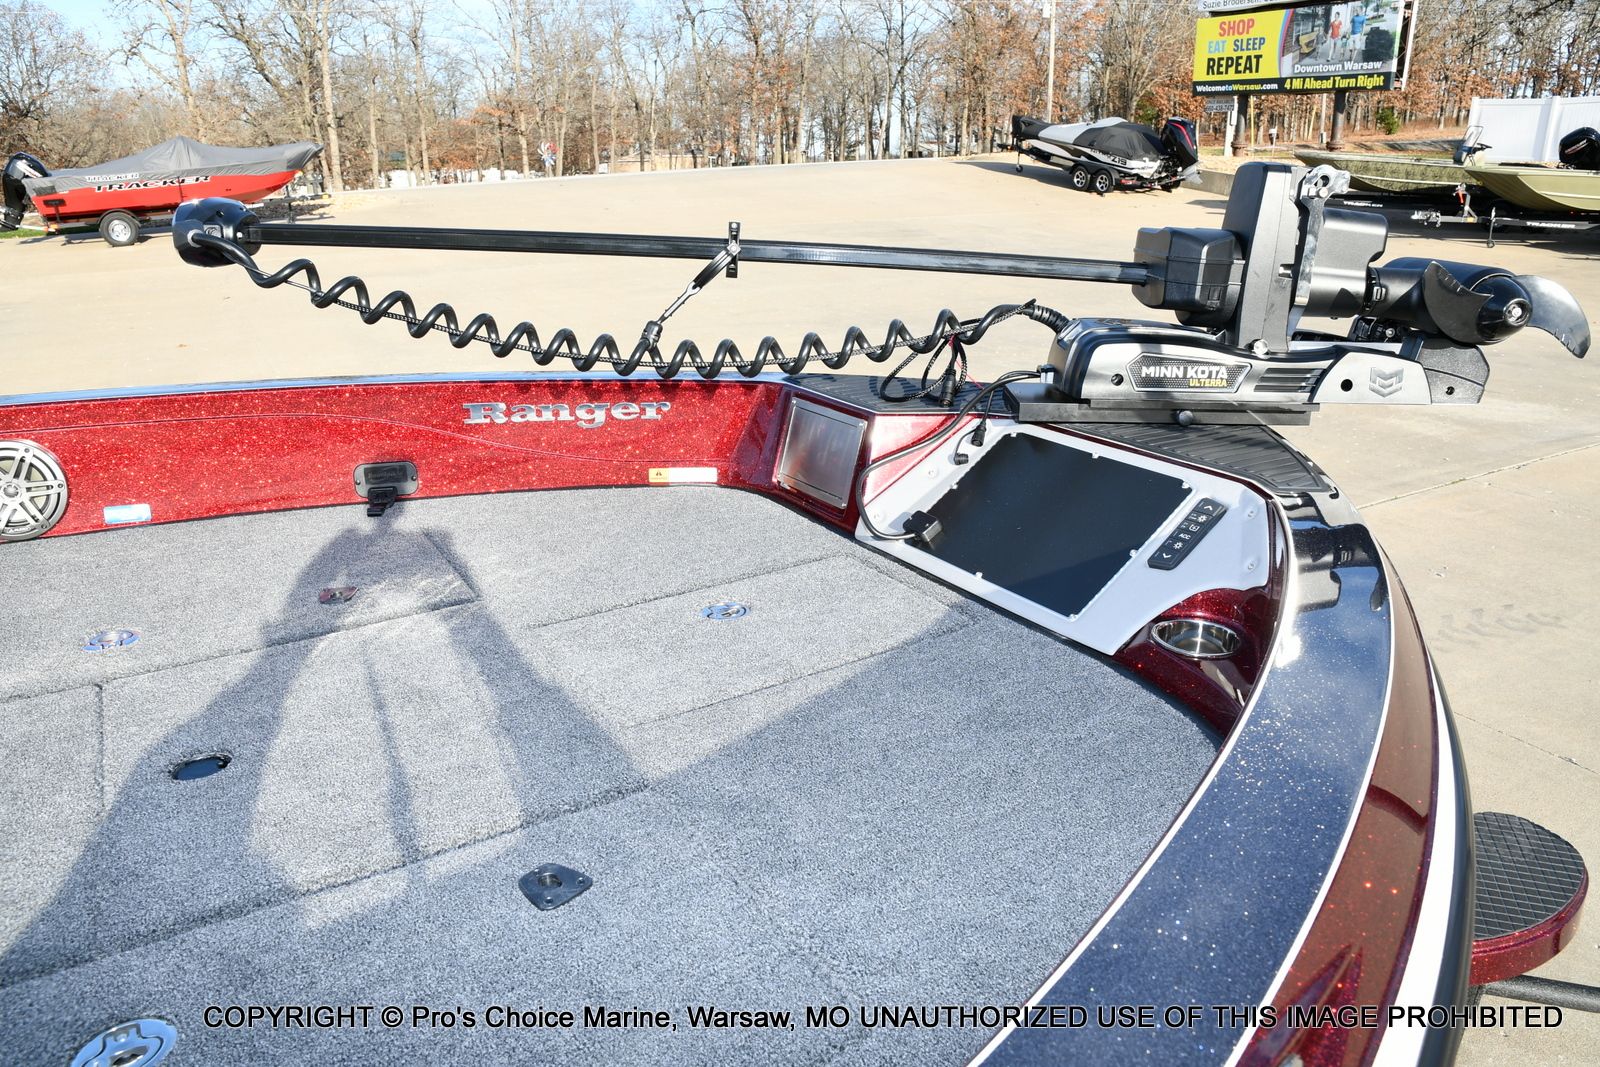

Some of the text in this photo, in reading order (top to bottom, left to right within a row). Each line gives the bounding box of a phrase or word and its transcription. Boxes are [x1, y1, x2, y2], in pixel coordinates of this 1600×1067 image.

[1219, 18, 1255, 37] SHOP
[1208, 37, 1266, 54] EAT SLEEP
[1206, 54, 1262, 76] REPEAT
[1294, 60, 1383, 74] Downtown Warsaw
[1196, 82, 1278, 92] WelcometoWarsaw.com
[1284, 74, 1385, 89] 4 Mi Ahead Turn Right
[95, 175, 211, 192] TRACKER
[1141, 365, 1228, 379] MINN KOTA
[1190, 379, 1227, 387] ULTERRA
[463, 401, 671, 428] Ranger
